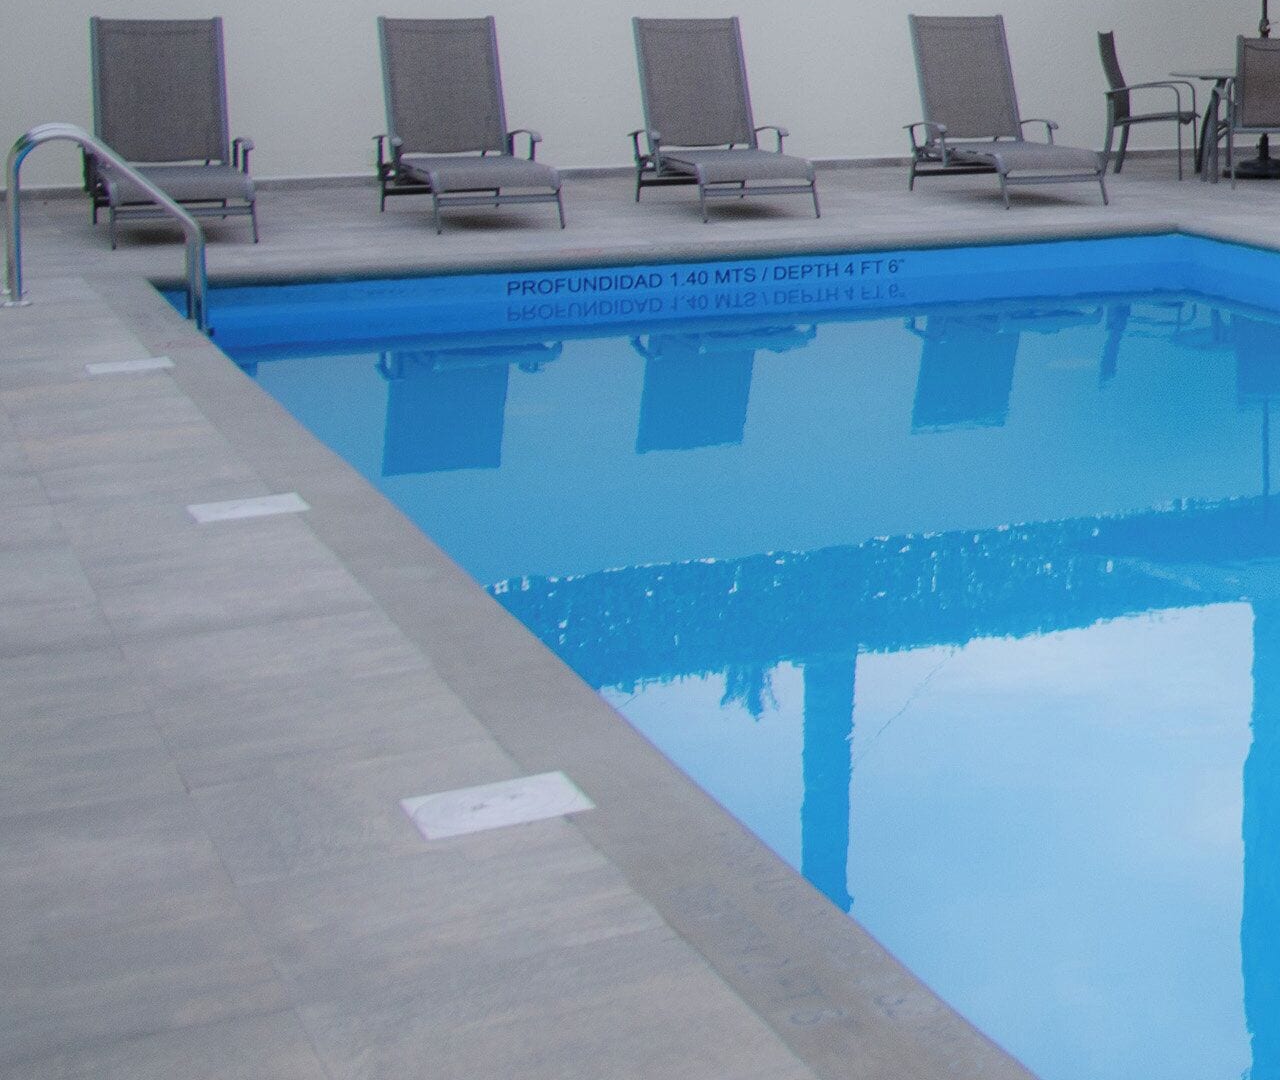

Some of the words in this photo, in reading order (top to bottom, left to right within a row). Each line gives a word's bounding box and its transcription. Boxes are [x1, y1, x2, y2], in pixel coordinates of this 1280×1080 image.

[506, 272, 663, 297] PROFUNDIDAD
[670, 271, 709, 288] 1.40
[715, 267, 757, 285] MTS
[761, 266, 768, 281] /
[773, 262, 839, 282] DEPTH
[844, 263, 855, 277] 4
[860, 260, 884, 276] FT
[888, 258, 905, 274] 6"
